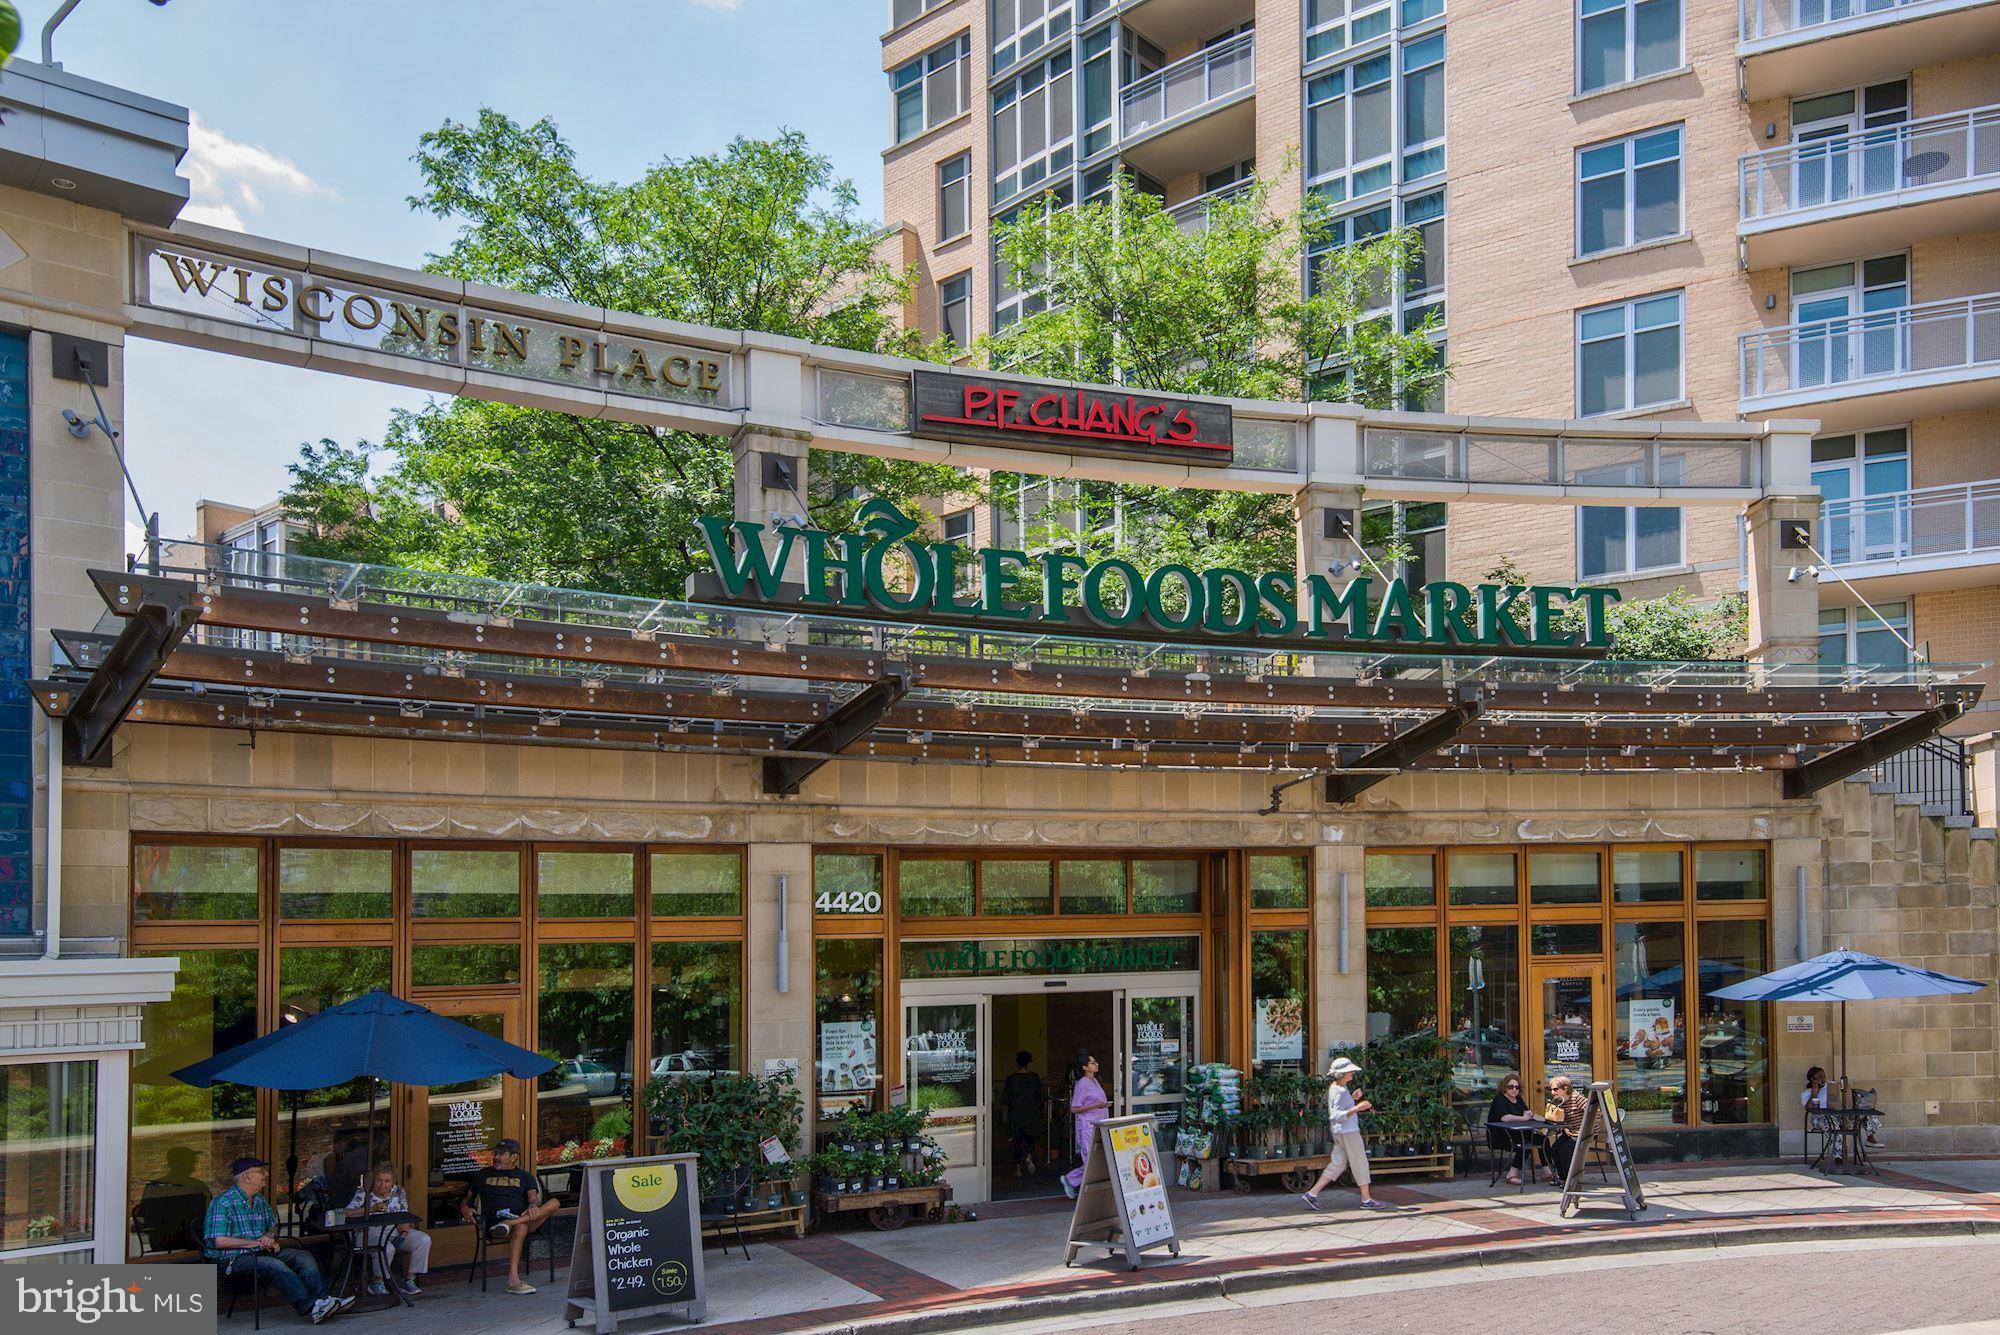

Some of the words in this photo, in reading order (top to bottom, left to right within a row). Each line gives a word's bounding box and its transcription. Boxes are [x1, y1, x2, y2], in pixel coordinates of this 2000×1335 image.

[159, 251, 531, 360] WISCONSIN
[559, 335, 723, 392] PLACE
[964, 384, 1023, 430] P.F.
[1030, 389, 1198, 446] CHANG'S
[693, 503, 1034, 621] WHOLE
[1039, 554, 1298, 638] FOODS
[1302, 573, 1622, 649] MARKET
[815, 891, 882, 913] 4420
[926, 941, 1008, 971] WHOLE
[1011, 949, 1085, 970] FOODS
[1086, 944, 1178, 968] MARKET
[1136, 1021, 1165, 1031] WHOLE
[936, 1029, 968, 1040] WHOLE
[1137, 1030, 1164, 1039] FOODS
[937, 1039, 967, 1048] FOODS
[1556, 1040, 1580, 1049] WHOLE
[449, 1099, 483, 1111] WHOLE
[450, 1110, 482, 1119] FOODS
[631, 1174, 662, 1188] Sale
[606, 1227, 650, 1242] Organic
[607, 1242, 641, 1256] Whole
[608, 1256, 653, 1271] Chicken
